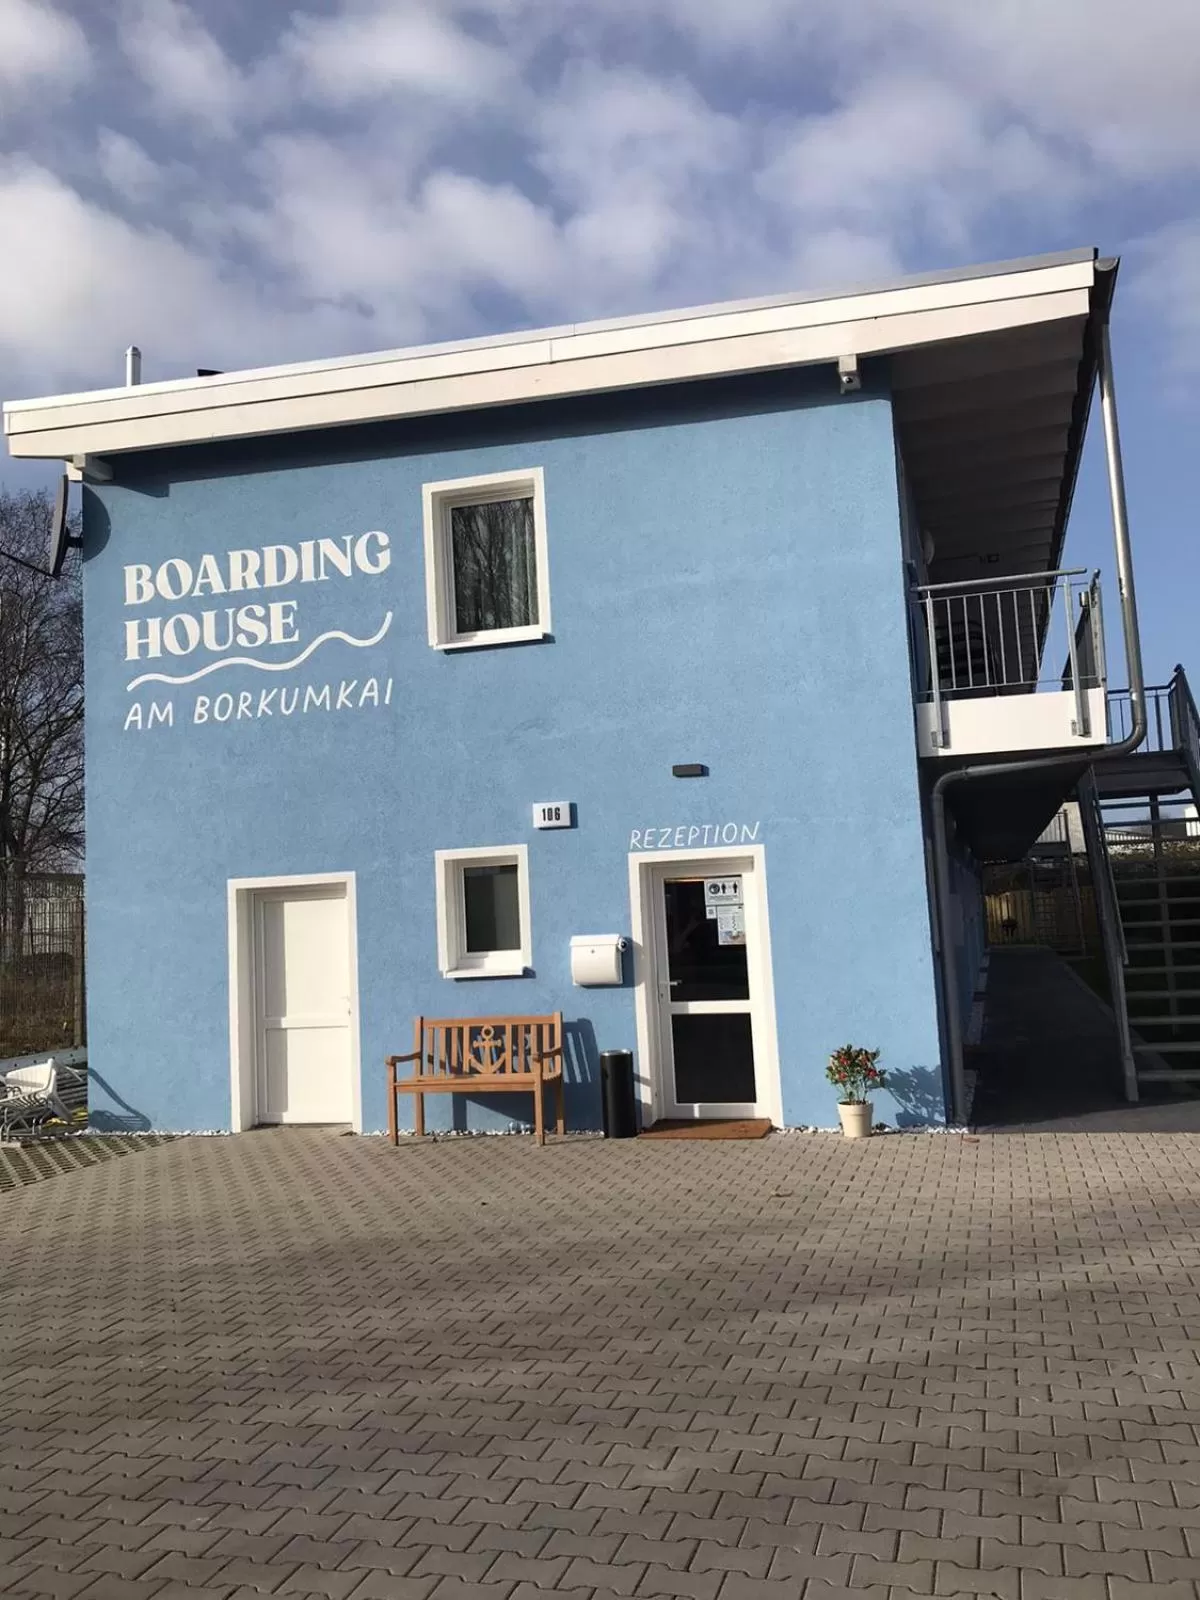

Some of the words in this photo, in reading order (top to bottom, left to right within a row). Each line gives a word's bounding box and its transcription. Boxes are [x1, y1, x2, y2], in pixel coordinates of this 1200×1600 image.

[124, 531, 391, 606] BOARDING
[124, 600, 299, 660] HOUSE
[124, 702, 174, 731] AM
[193, 678, 393, 724] BORKUMKAI
[541, 807, 561, 821] 106
[629, 821, 760, 850] REZEPTION
